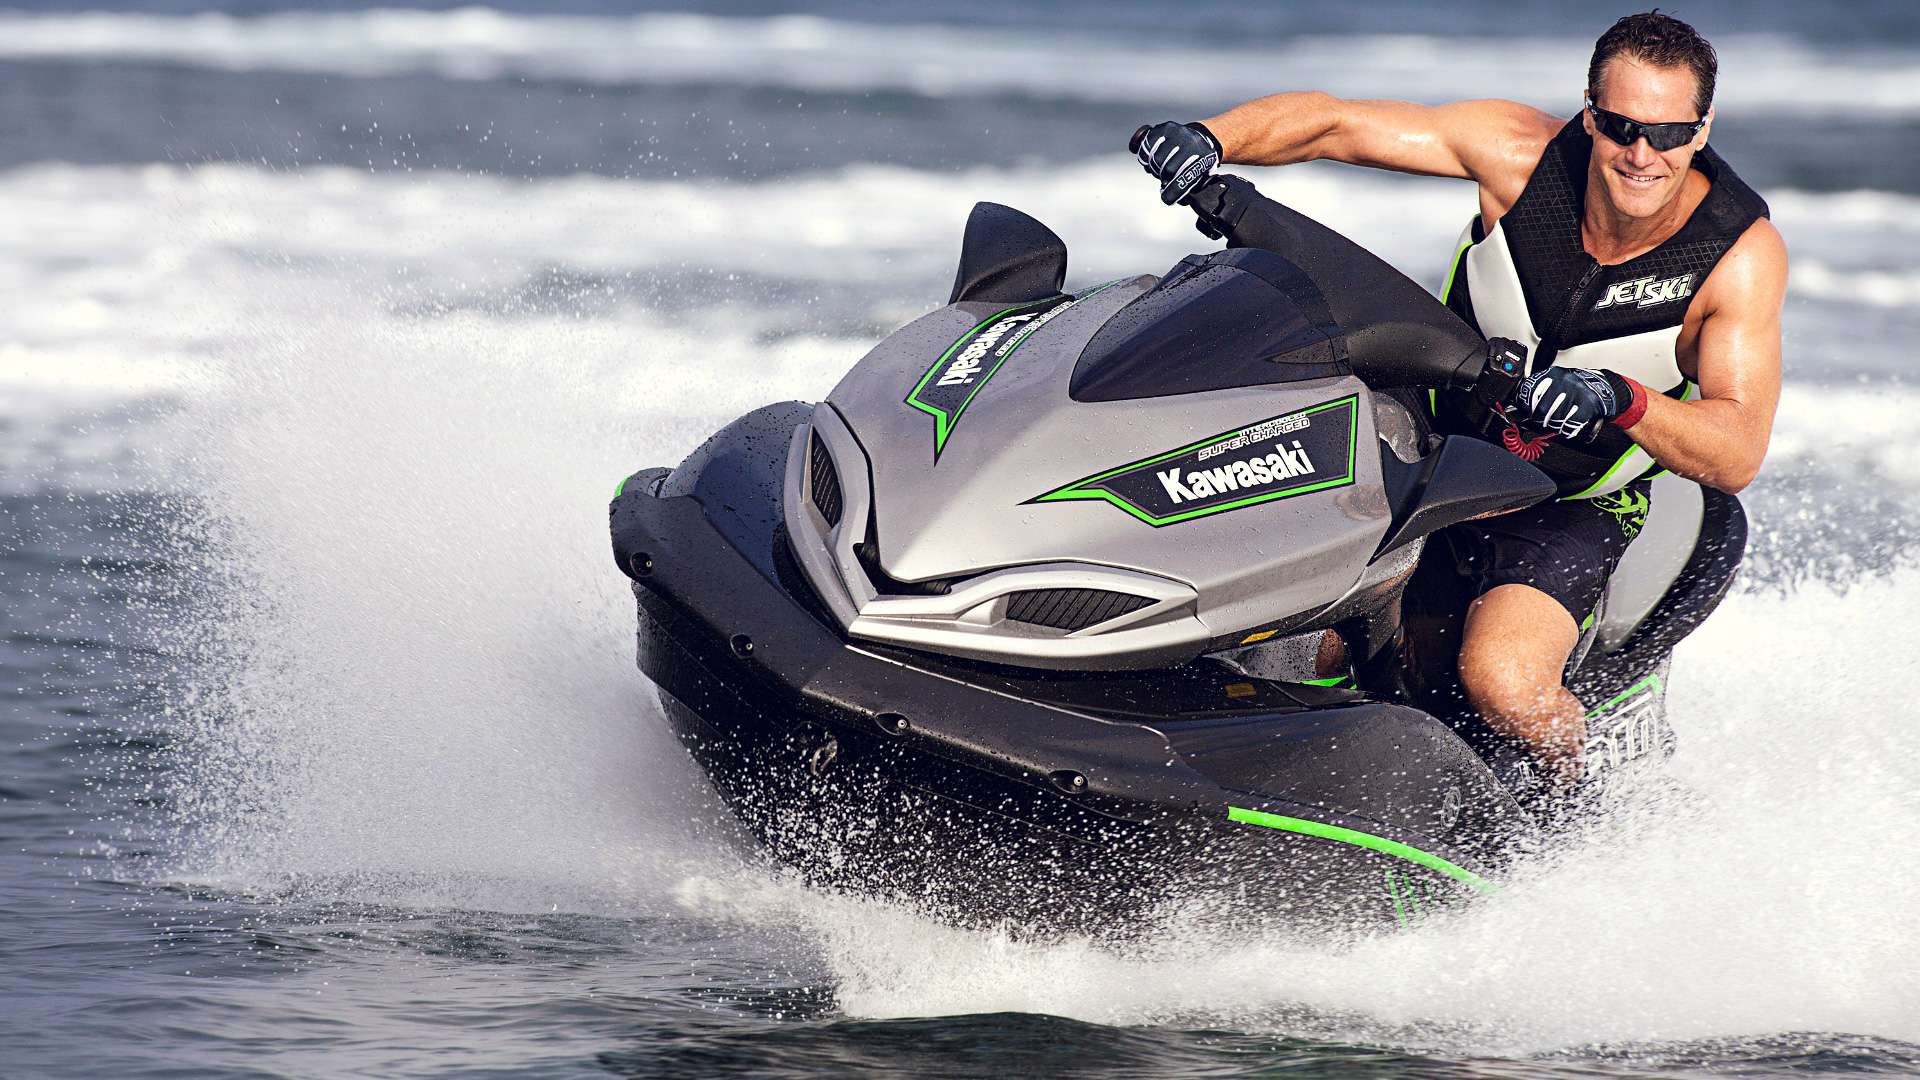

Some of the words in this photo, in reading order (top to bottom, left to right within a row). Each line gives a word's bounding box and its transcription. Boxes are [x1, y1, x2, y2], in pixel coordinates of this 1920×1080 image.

[936, 312, 1039, 386] Kawasaki
[1156, 439, 1316, 504] Kawasaki
[1198, 436, 1250, 461] SUPER
[1249, 417, 1311, 443] CHARGED
